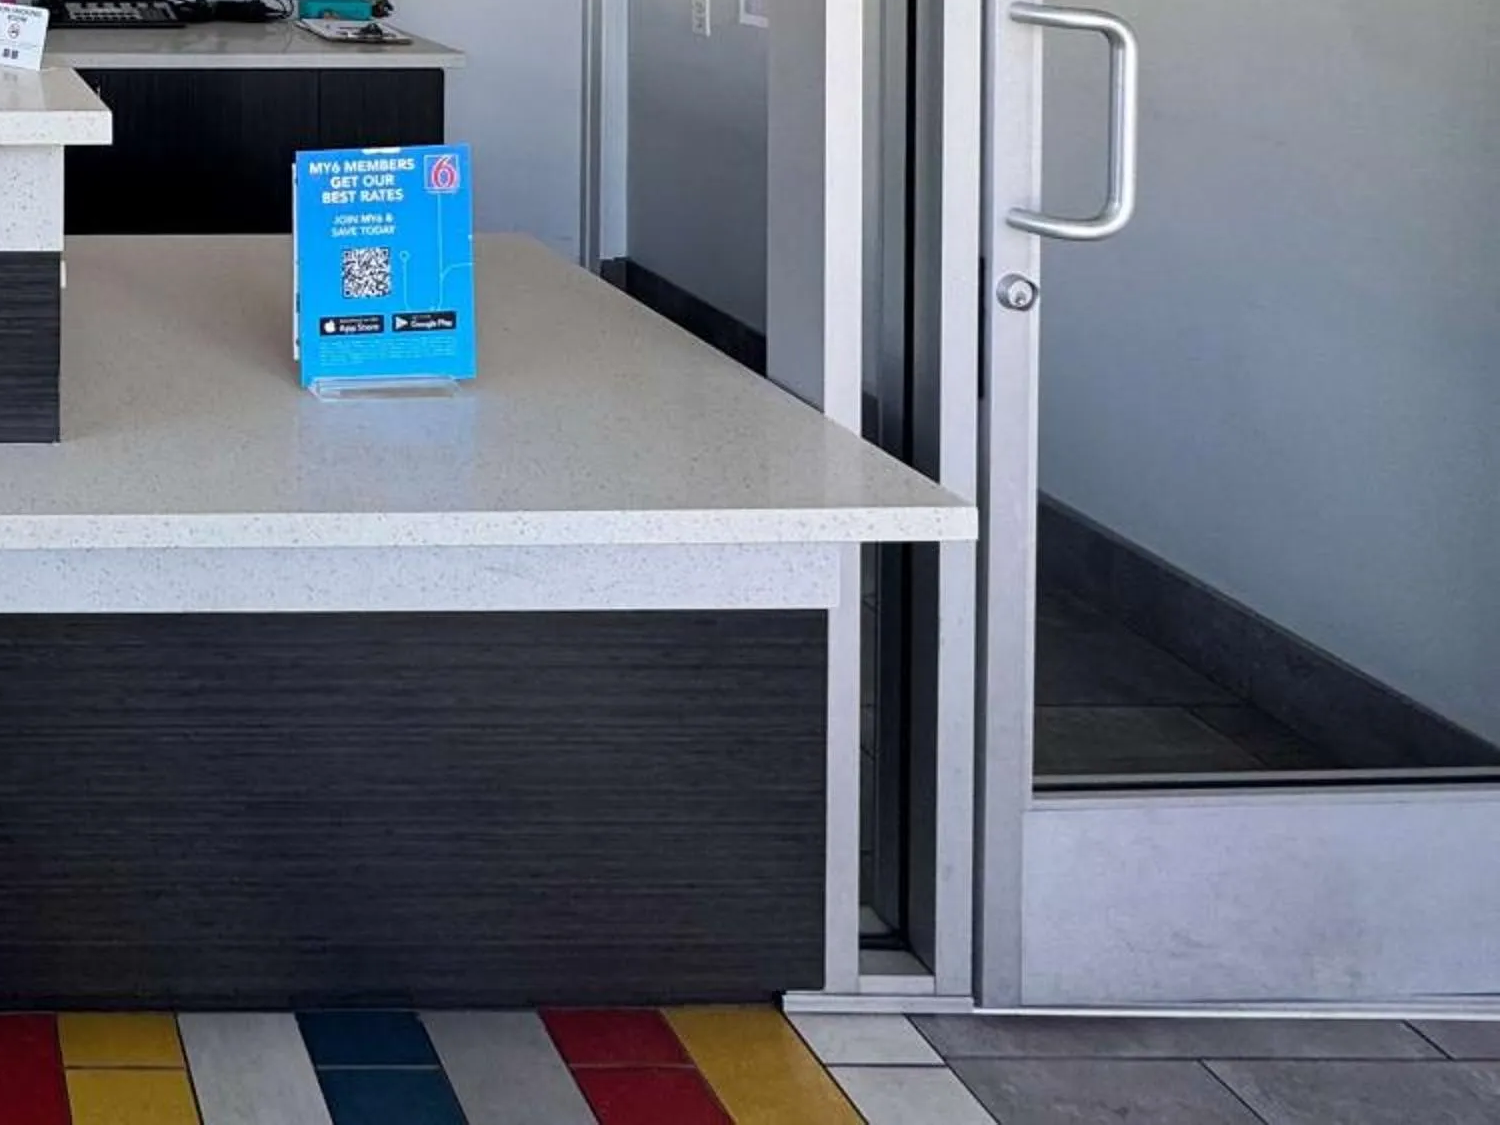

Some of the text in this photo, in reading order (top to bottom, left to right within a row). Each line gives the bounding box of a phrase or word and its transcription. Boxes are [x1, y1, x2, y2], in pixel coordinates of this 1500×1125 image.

[309, 157, 416, 175] MY6 MEMBERS
[330, 173, 396, 190] GET OUR
[321, 188, 405, 205] BEST RATES
[331, 224, 397, 238] SAVE TODAY
